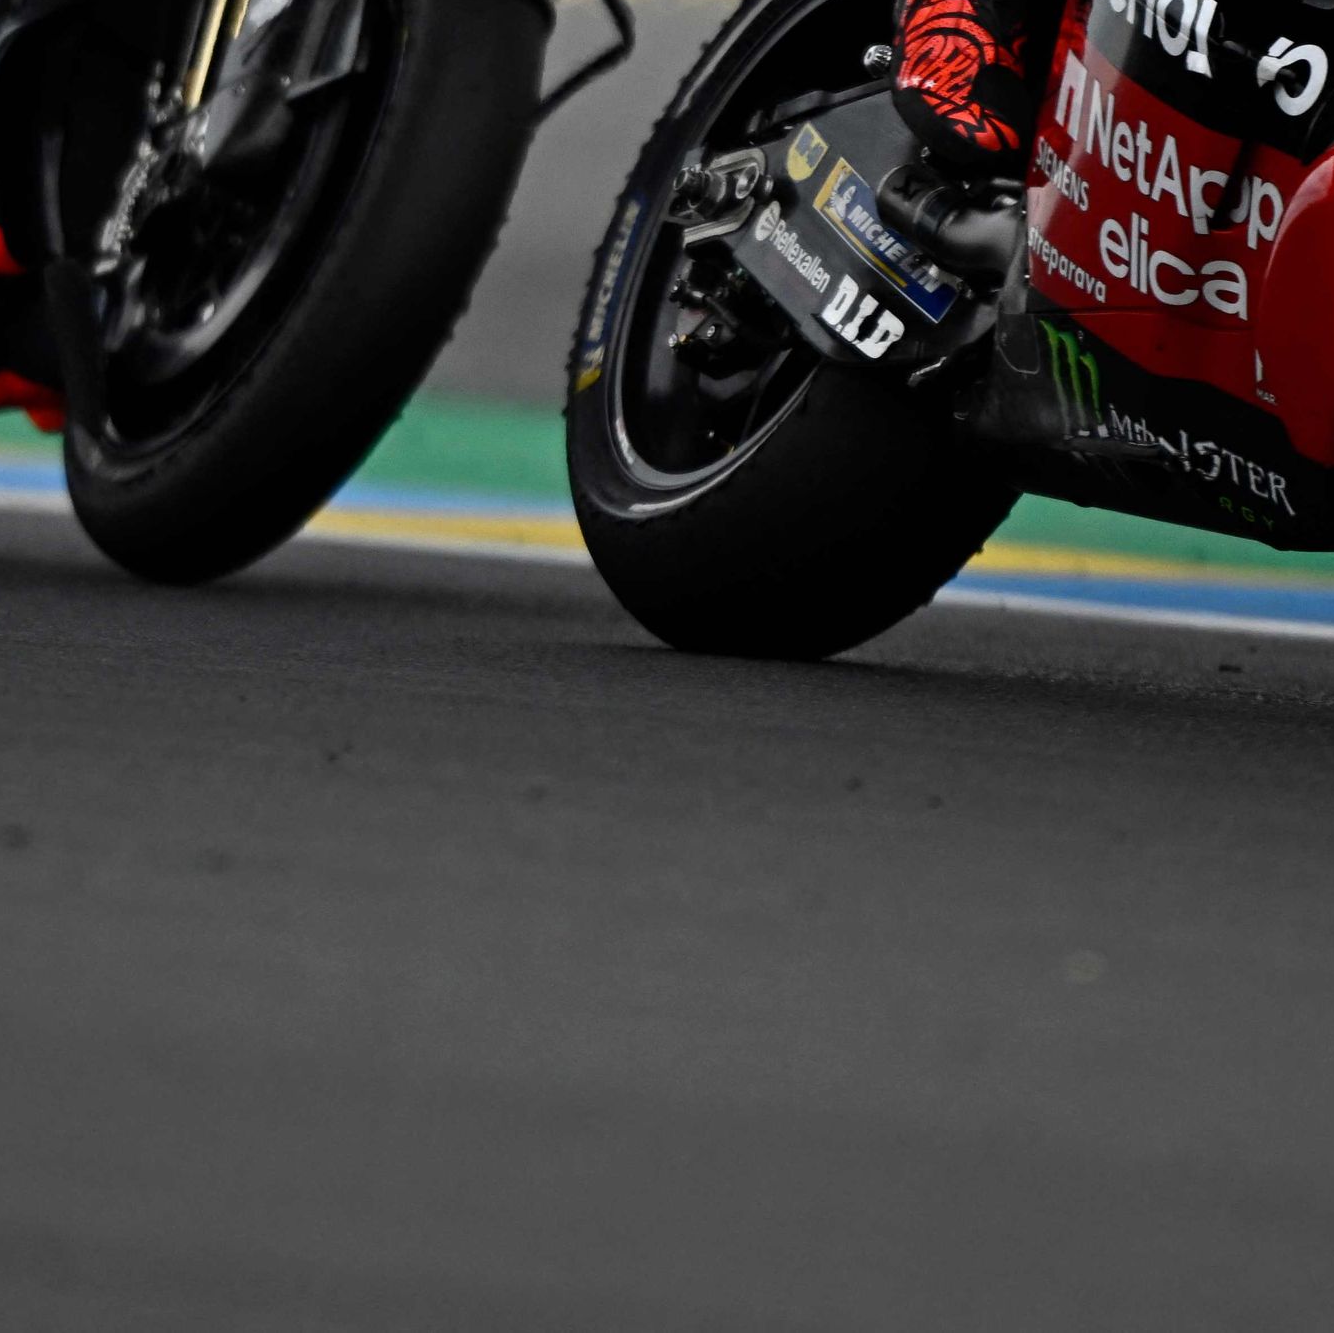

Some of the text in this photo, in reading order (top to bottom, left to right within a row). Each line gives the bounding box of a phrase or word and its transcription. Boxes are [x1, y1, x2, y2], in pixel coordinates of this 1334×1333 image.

[1034, 136, 1090, 213] SIEMENS
[1085, 79, 1284, 250] NetApp
[771, 219, 831, 294] Reflexallen
[1028, 226, 1107, 304] streparava
[1098, 212, 1248, 322] elica
